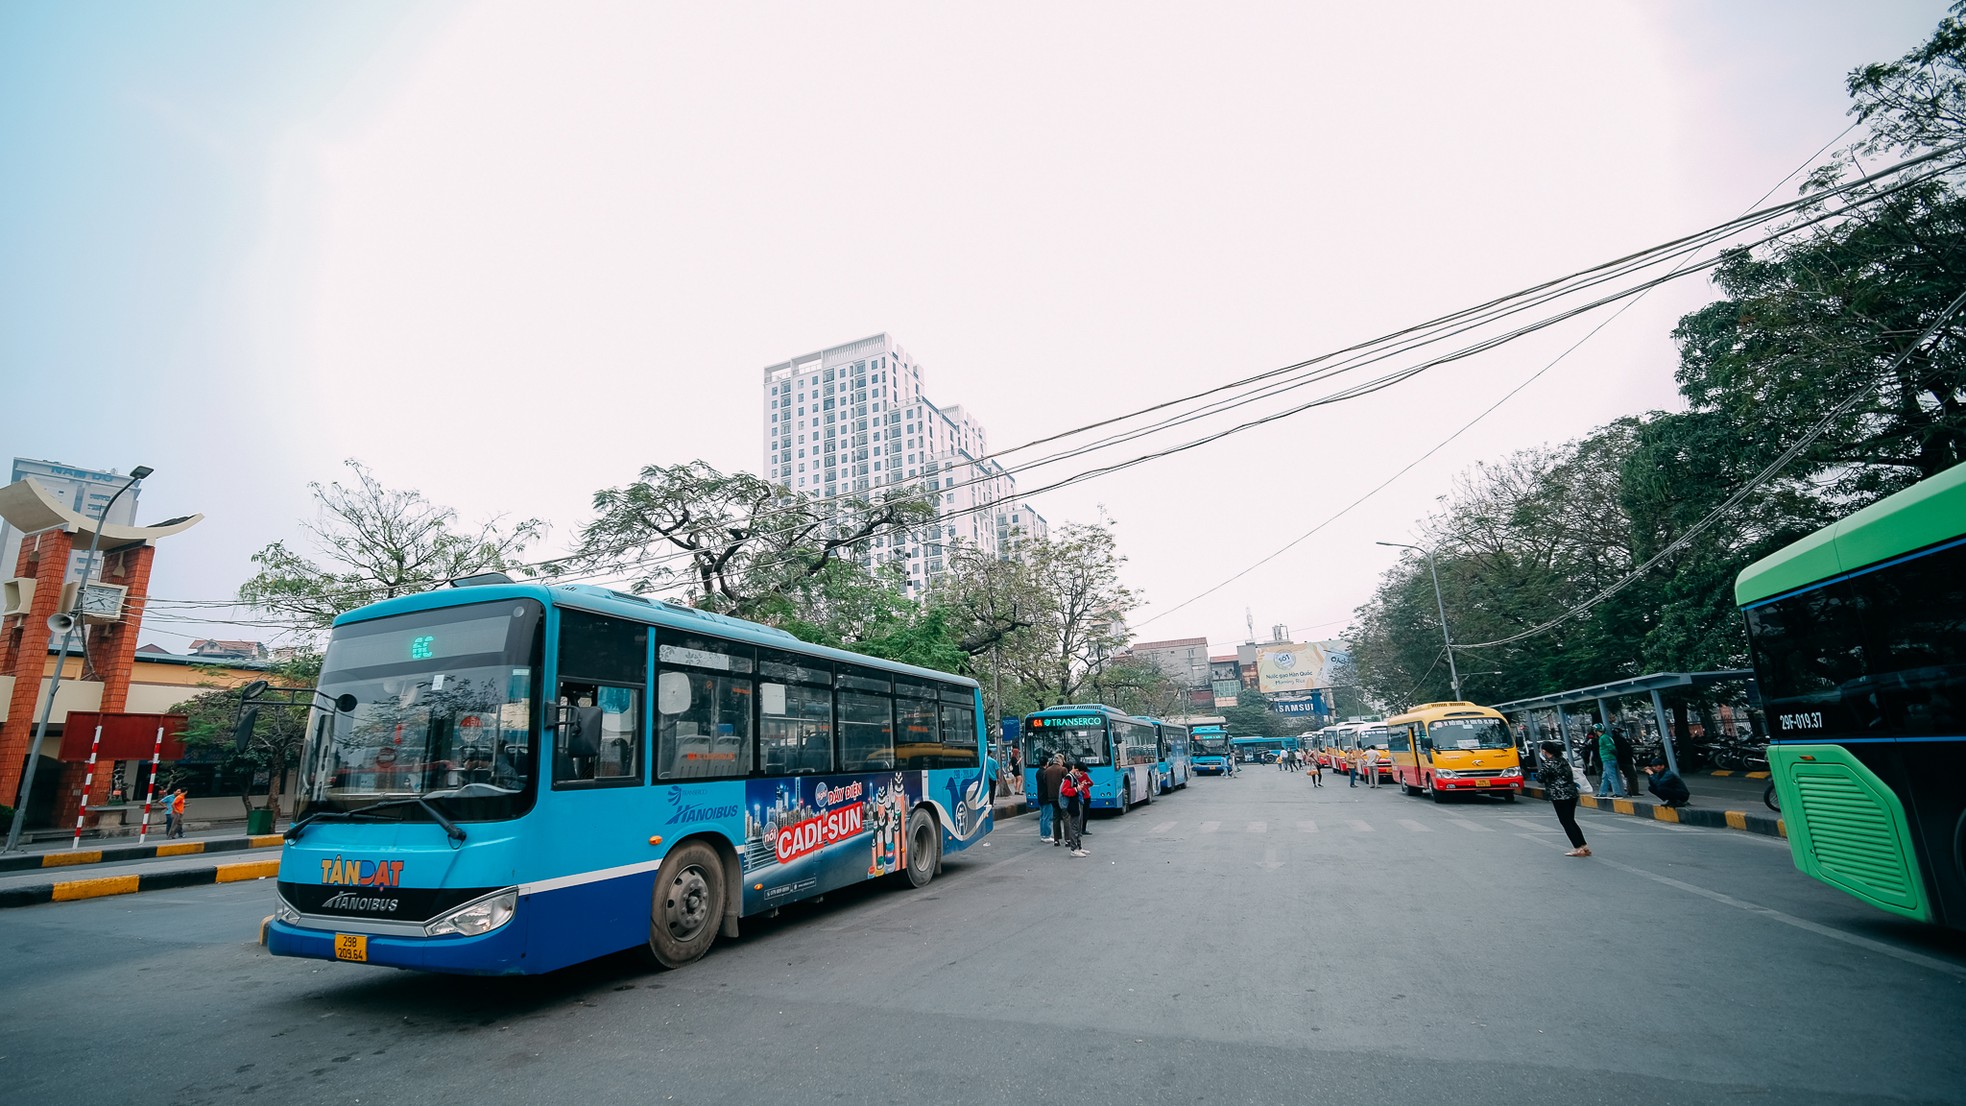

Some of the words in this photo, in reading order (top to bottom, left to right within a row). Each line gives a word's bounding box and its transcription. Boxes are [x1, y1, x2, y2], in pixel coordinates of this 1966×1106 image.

[1033, 719, 1043, 727] 6A
[1052, 717, 1101, 726] TRANSERCO
[1780, 711, 1823, 730] 29F-019.37
[664, 803, 738, 825] HANOIBUS
[778, 806, 861, 859] CADI-SUN
[322, 891, 399, 911] HANOIBUS
[343, 936, 357, 947] 29B
[338, 947, 363, 960] 209.64
